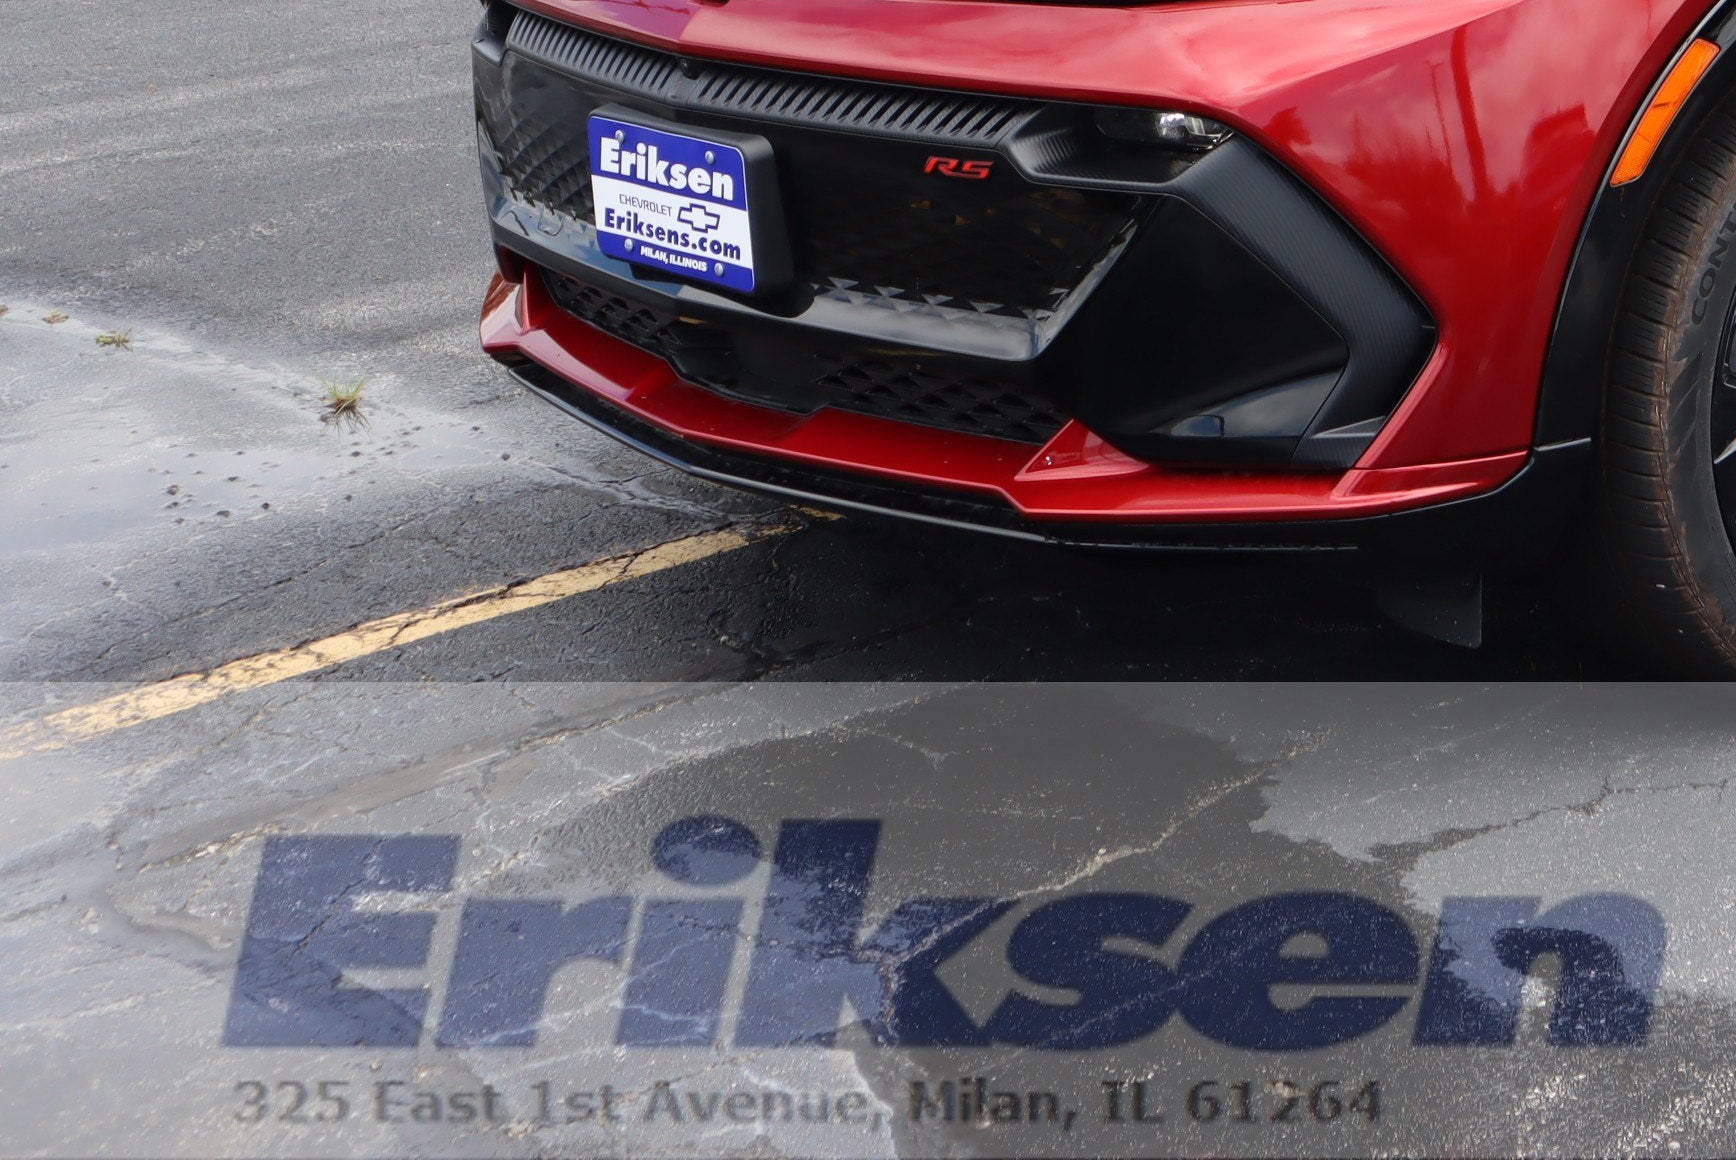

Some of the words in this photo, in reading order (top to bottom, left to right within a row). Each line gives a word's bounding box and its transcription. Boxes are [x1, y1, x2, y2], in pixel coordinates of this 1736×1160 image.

[600, 136, 733, 201] Eriksen
[924, 156, 994, 179] RS
[618, 193, 673, 217] CHEVROLET
[604, 207, 741, 261] Eriksens.com
[640, 245, 669, 265] MILAN,
[669, 252, 707, 272] ILLINOIS
